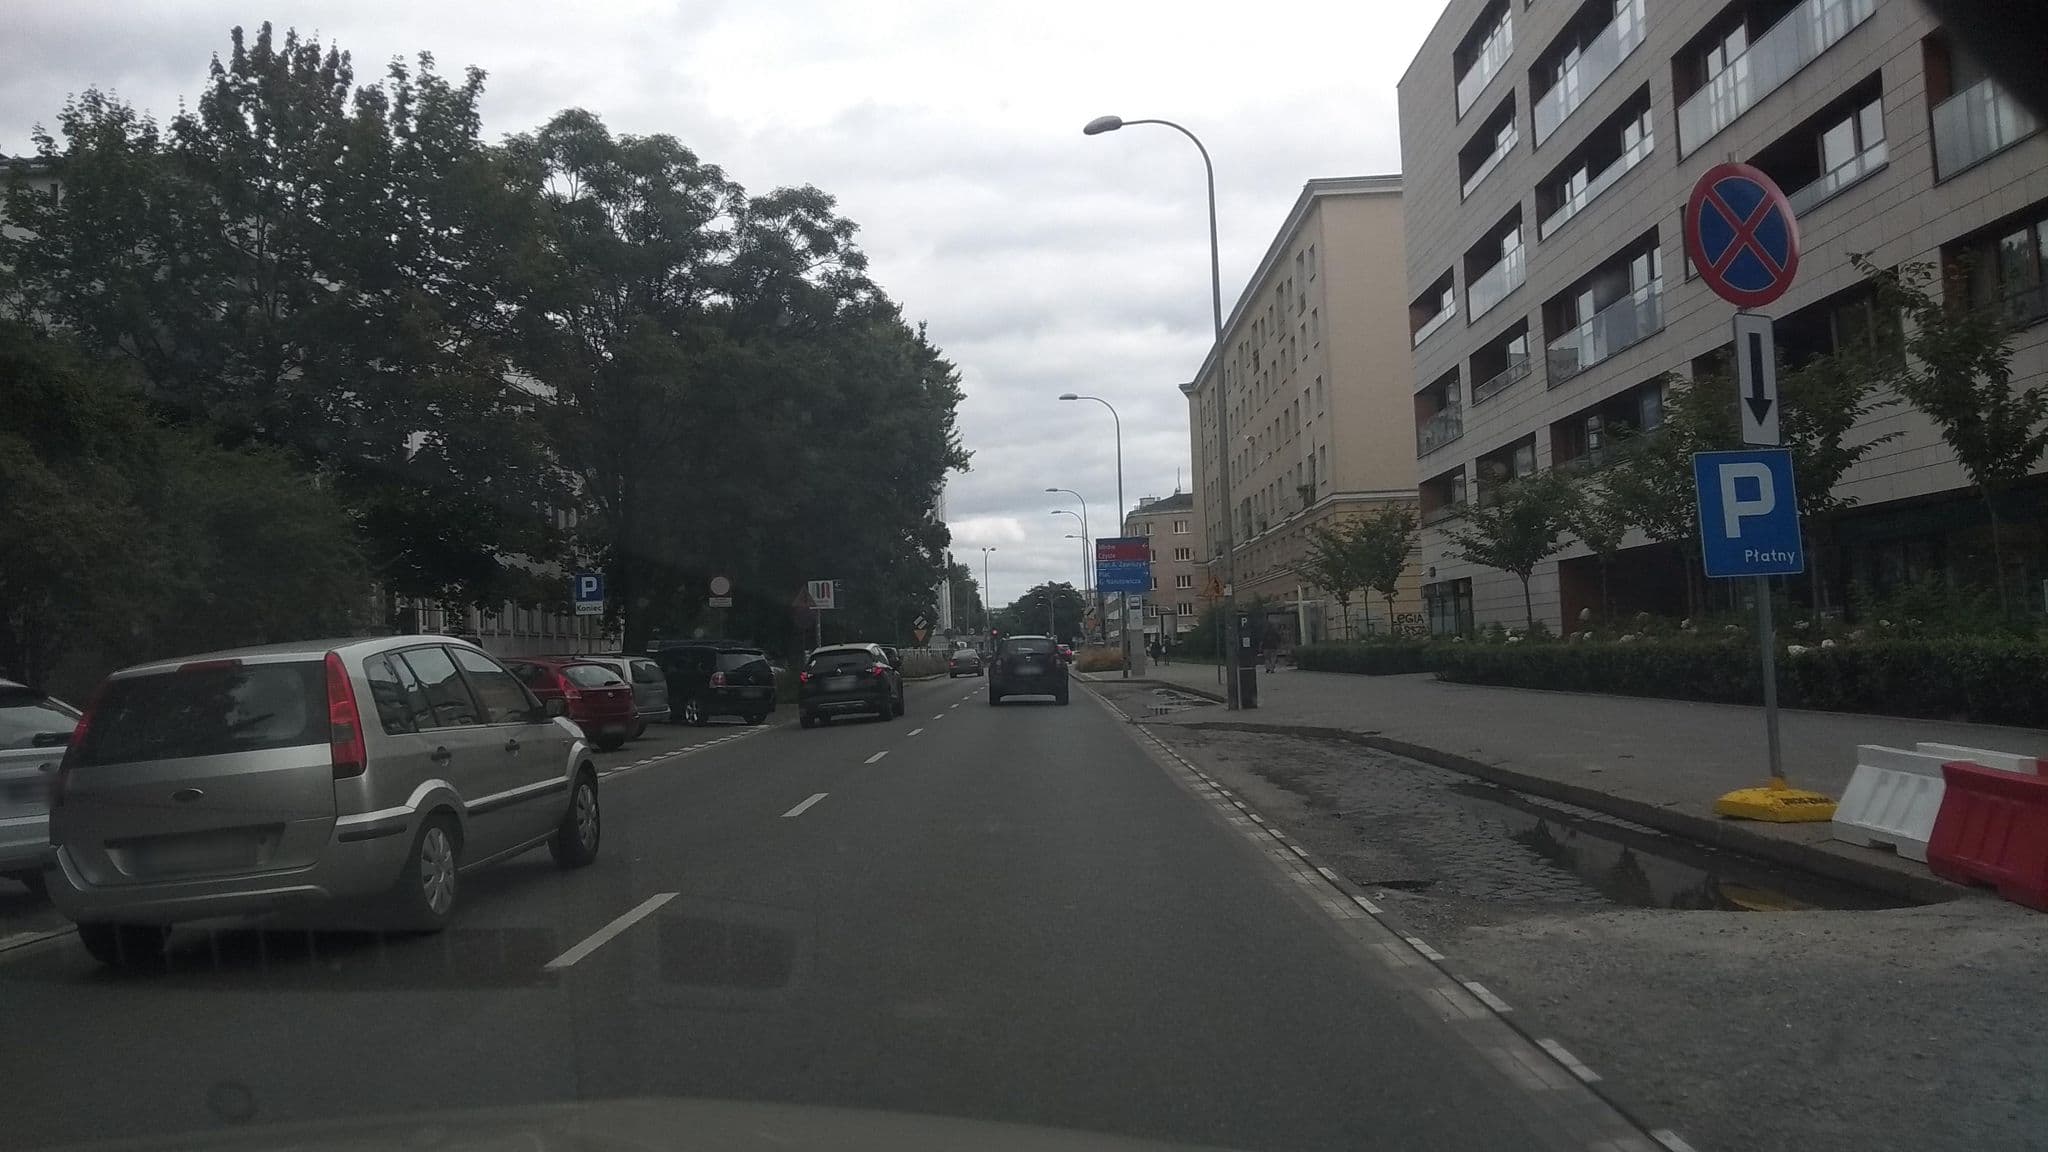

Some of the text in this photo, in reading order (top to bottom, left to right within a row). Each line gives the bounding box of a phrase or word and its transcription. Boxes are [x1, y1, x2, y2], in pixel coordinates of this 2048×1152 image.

[1719, 462, 1776, 538] P
[1745, 549, 1796, 565] Płatny
[582, 576, 597, 598] P
[1241, 617, 1248, 627] P
